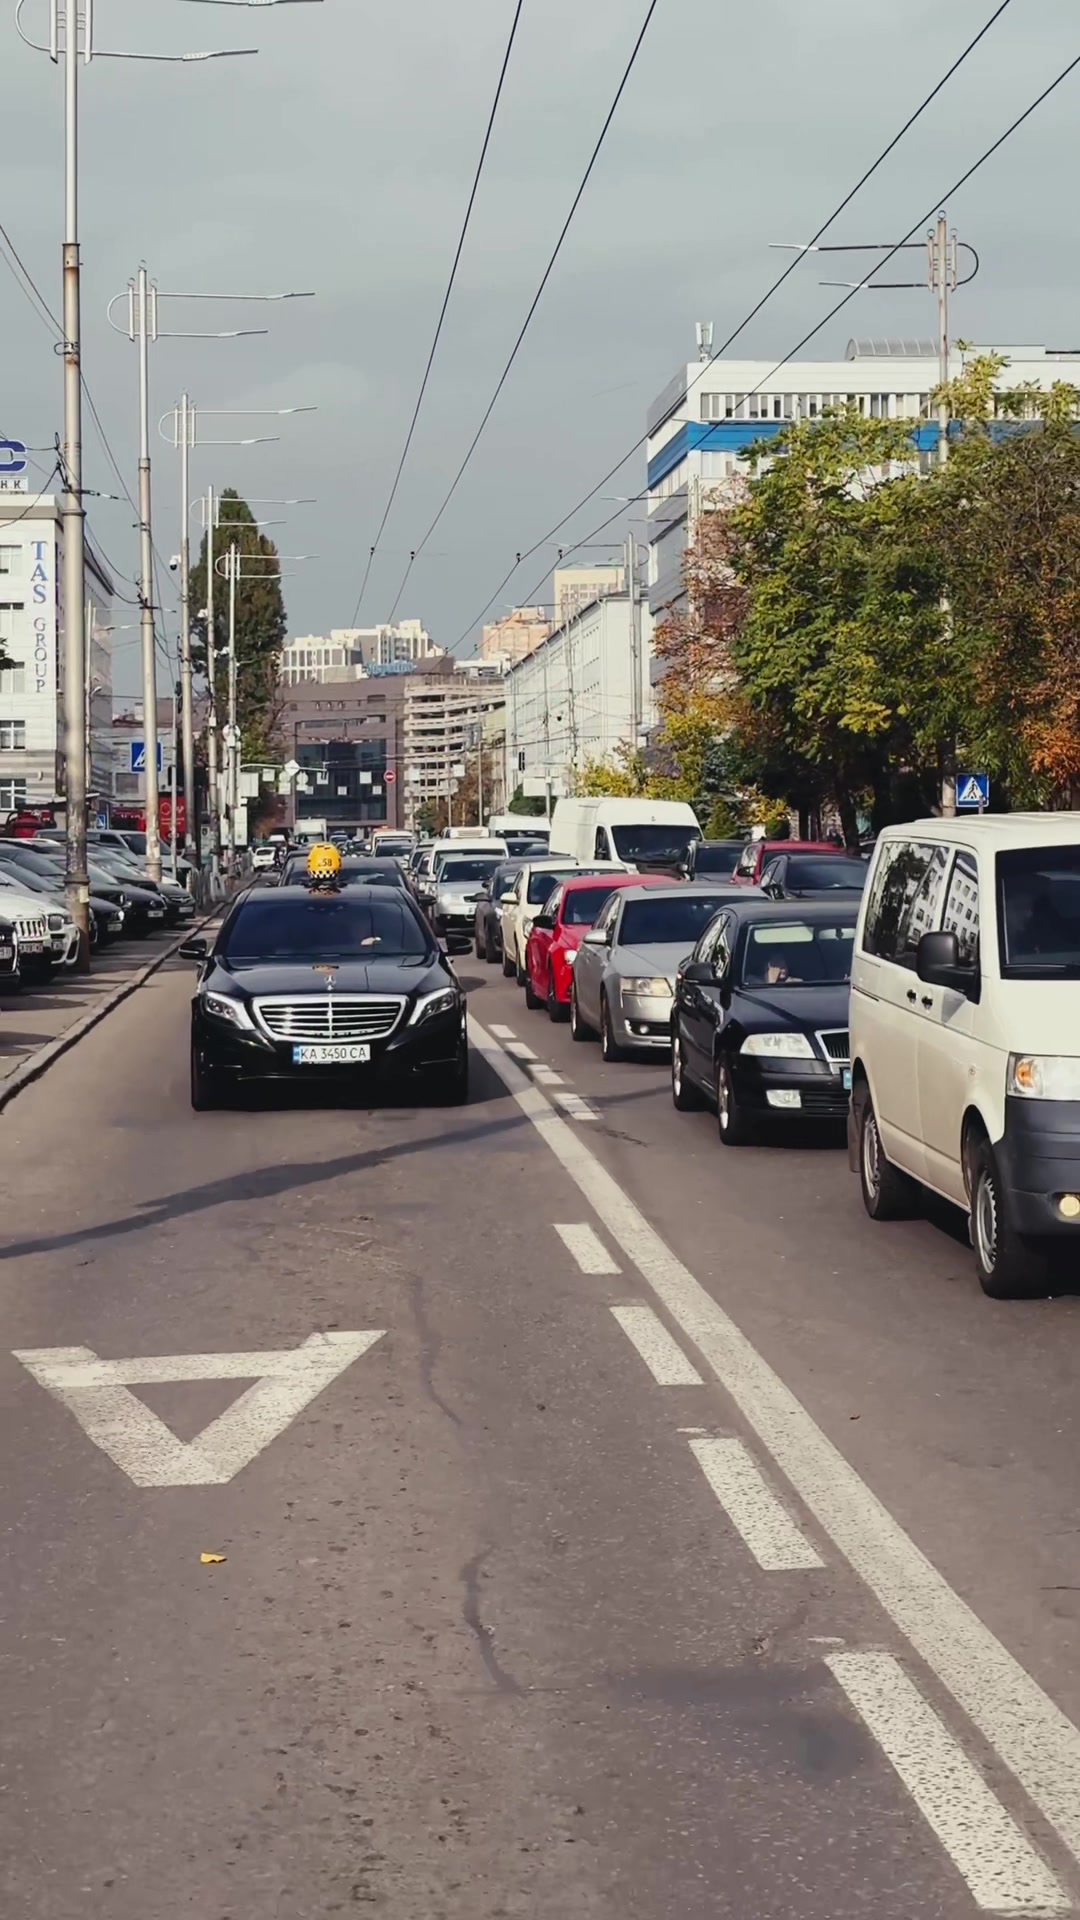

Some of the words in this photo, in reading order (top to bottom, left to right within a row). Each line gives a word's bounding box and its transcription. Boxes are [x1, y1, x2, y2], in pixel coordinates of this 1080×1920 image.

[31, 540, 48, 604] TAS
[33, 617, 47, 693] GROUP
[301, 1048, 317, 1060] KA
[321, 1047, 347, 1060] 3450
[349, 1047, 366, 1059] CA
